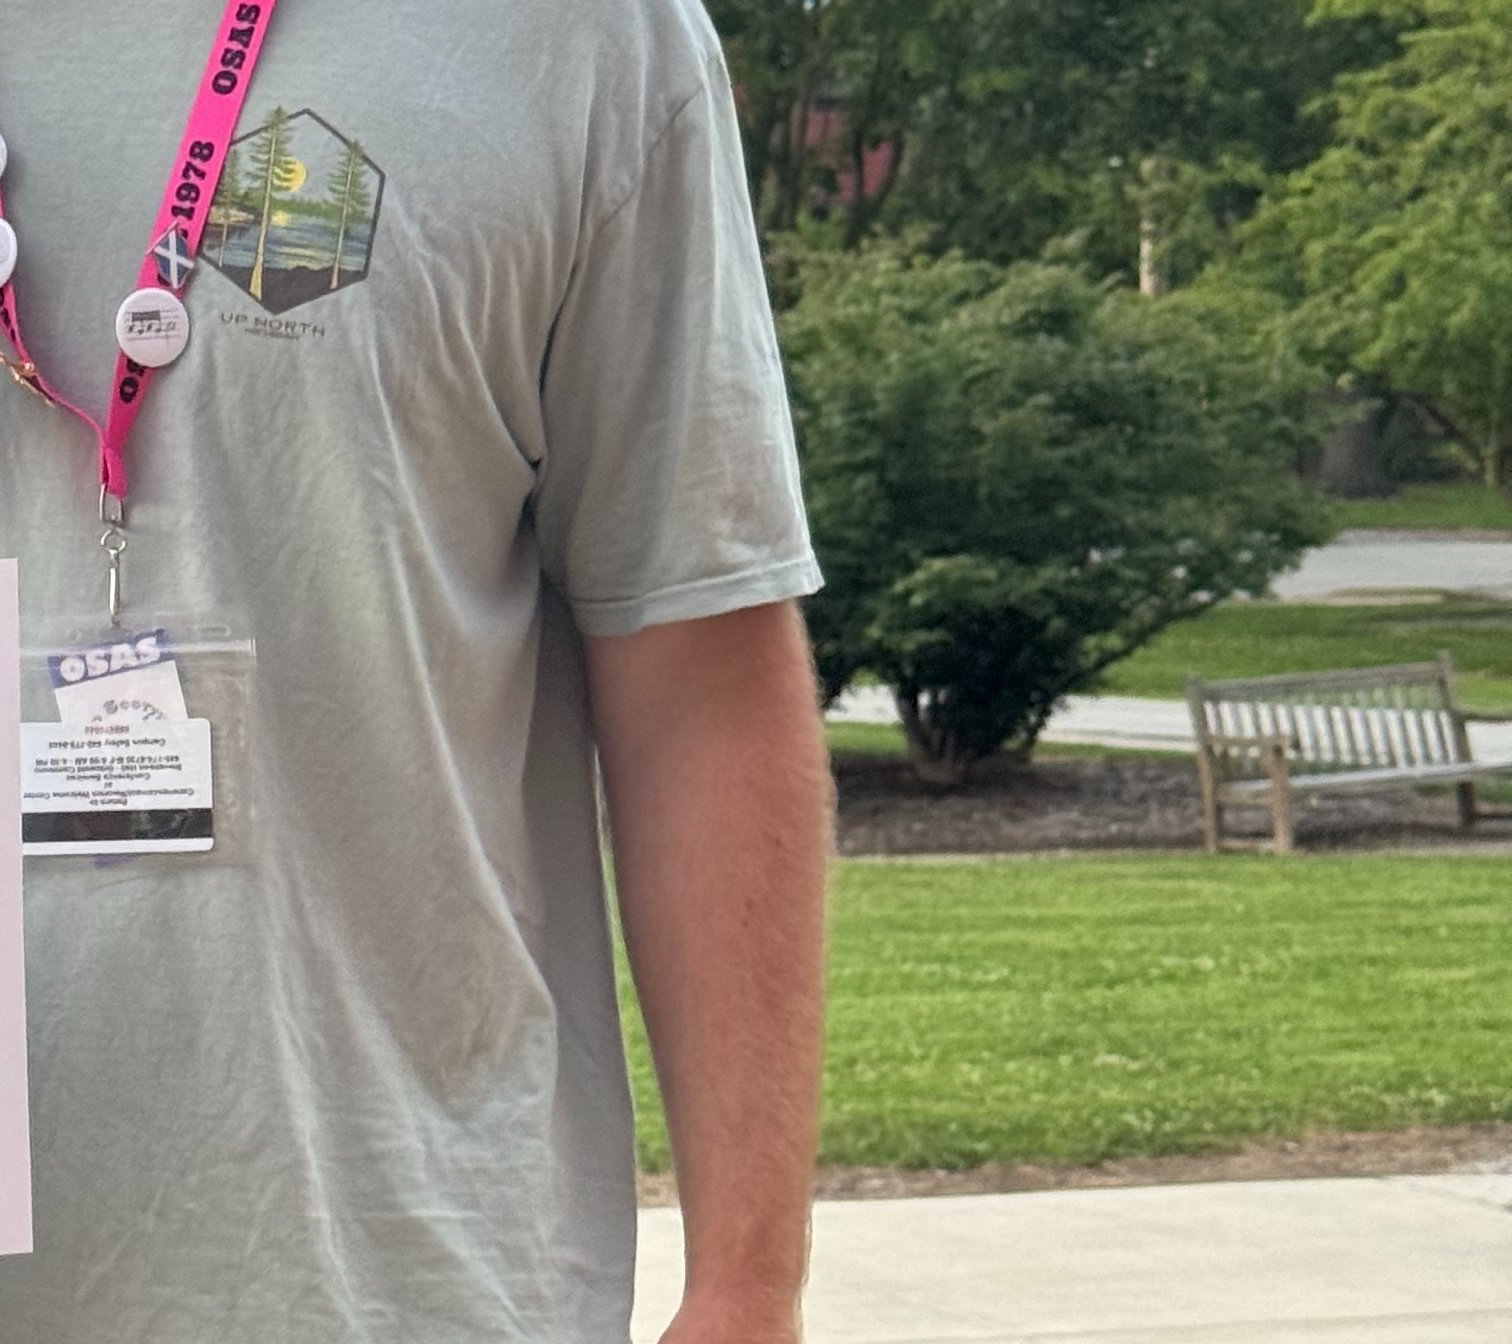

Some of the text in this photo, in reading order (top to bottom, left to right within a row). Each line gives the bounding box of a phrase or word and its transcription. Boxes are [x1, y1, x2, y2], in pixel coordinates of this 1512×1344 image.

[211, 3, 262, 96] OSAS
[171, 140, 216, 221] 1978
[221, 312, 248, 323] UP
[254, 317, 326, 337] NORTH
[59, 636, 162, 683] OSAS
